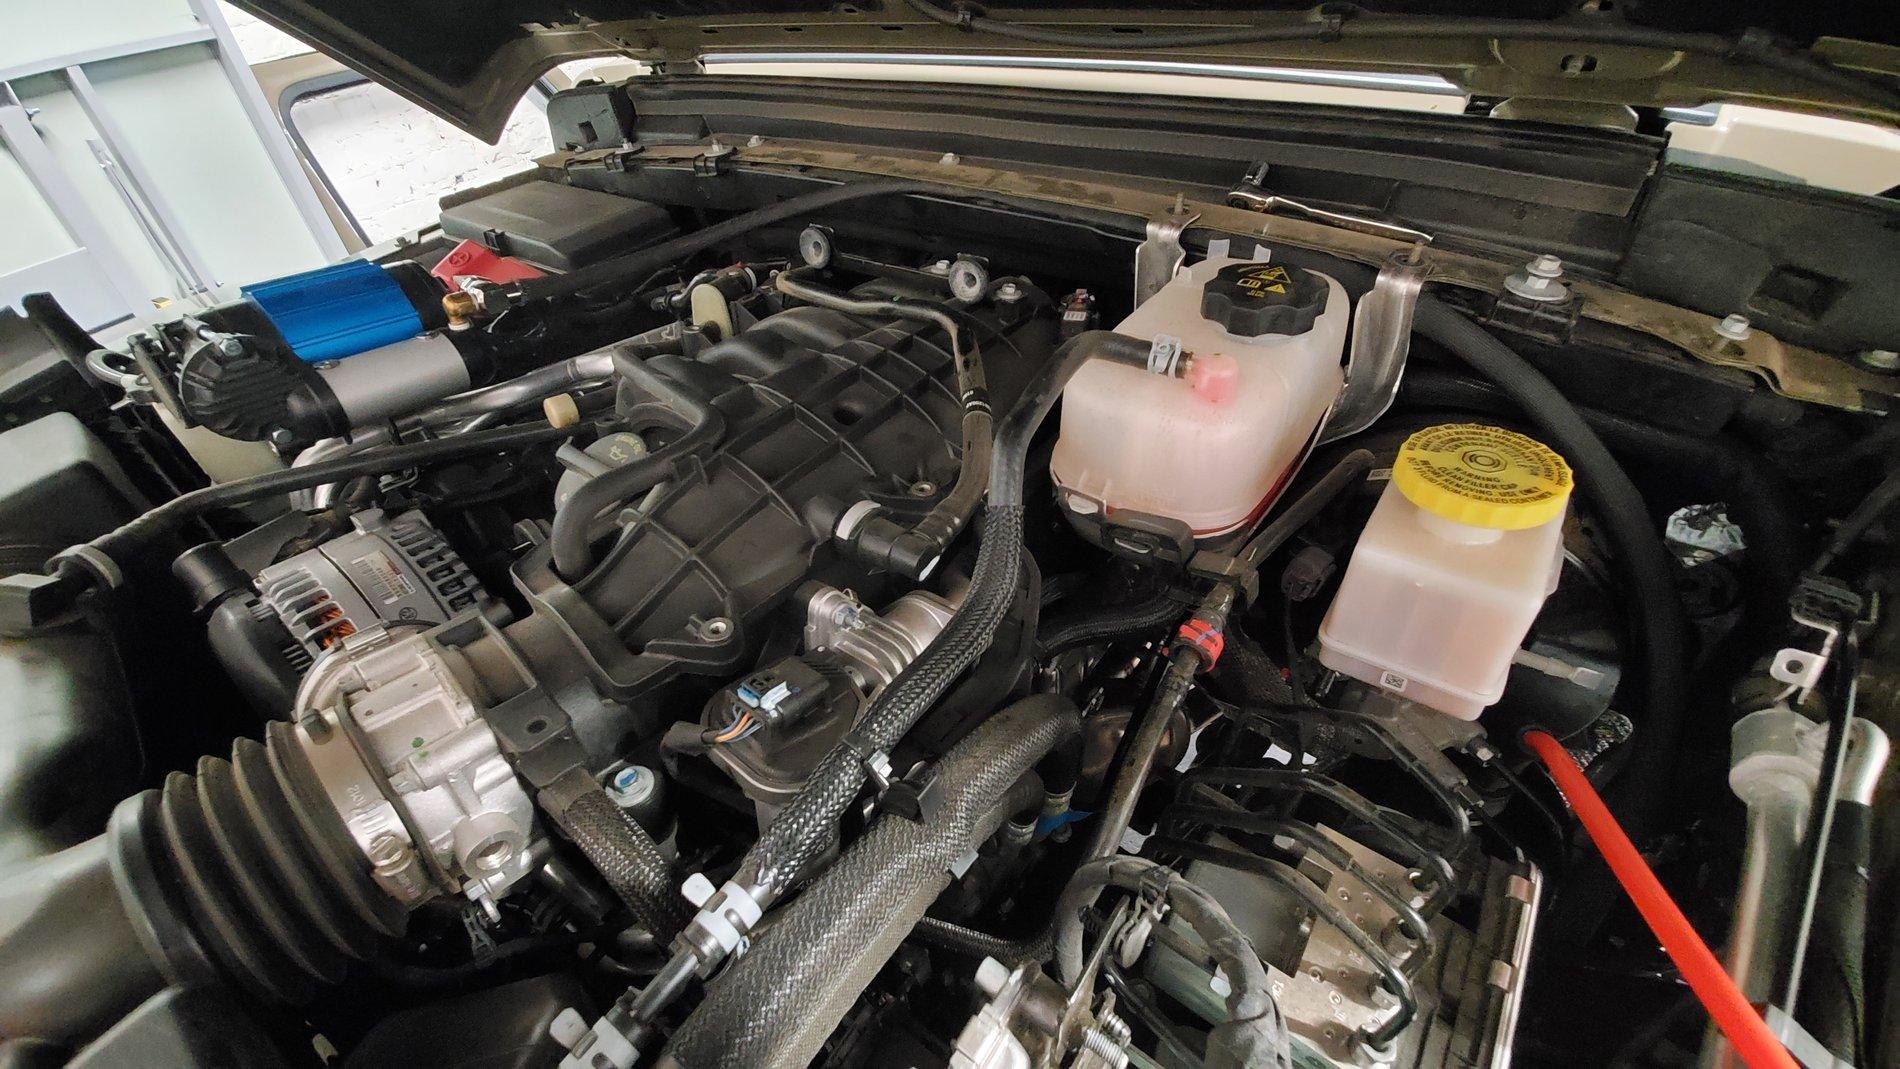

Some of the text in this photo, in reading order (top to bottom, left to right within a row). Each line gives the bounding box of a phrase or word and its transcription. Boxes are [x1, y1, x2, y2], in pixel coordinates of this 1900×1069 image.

[1414, 469, 1439, 485] FLUID
[1435, 482, 1462, 496] FROM
[1472, 493, 1507, 503] SEALED
[1438, 466, 1464, 482] CLEAN
[1464, 479, 1497, 490] FILLER
